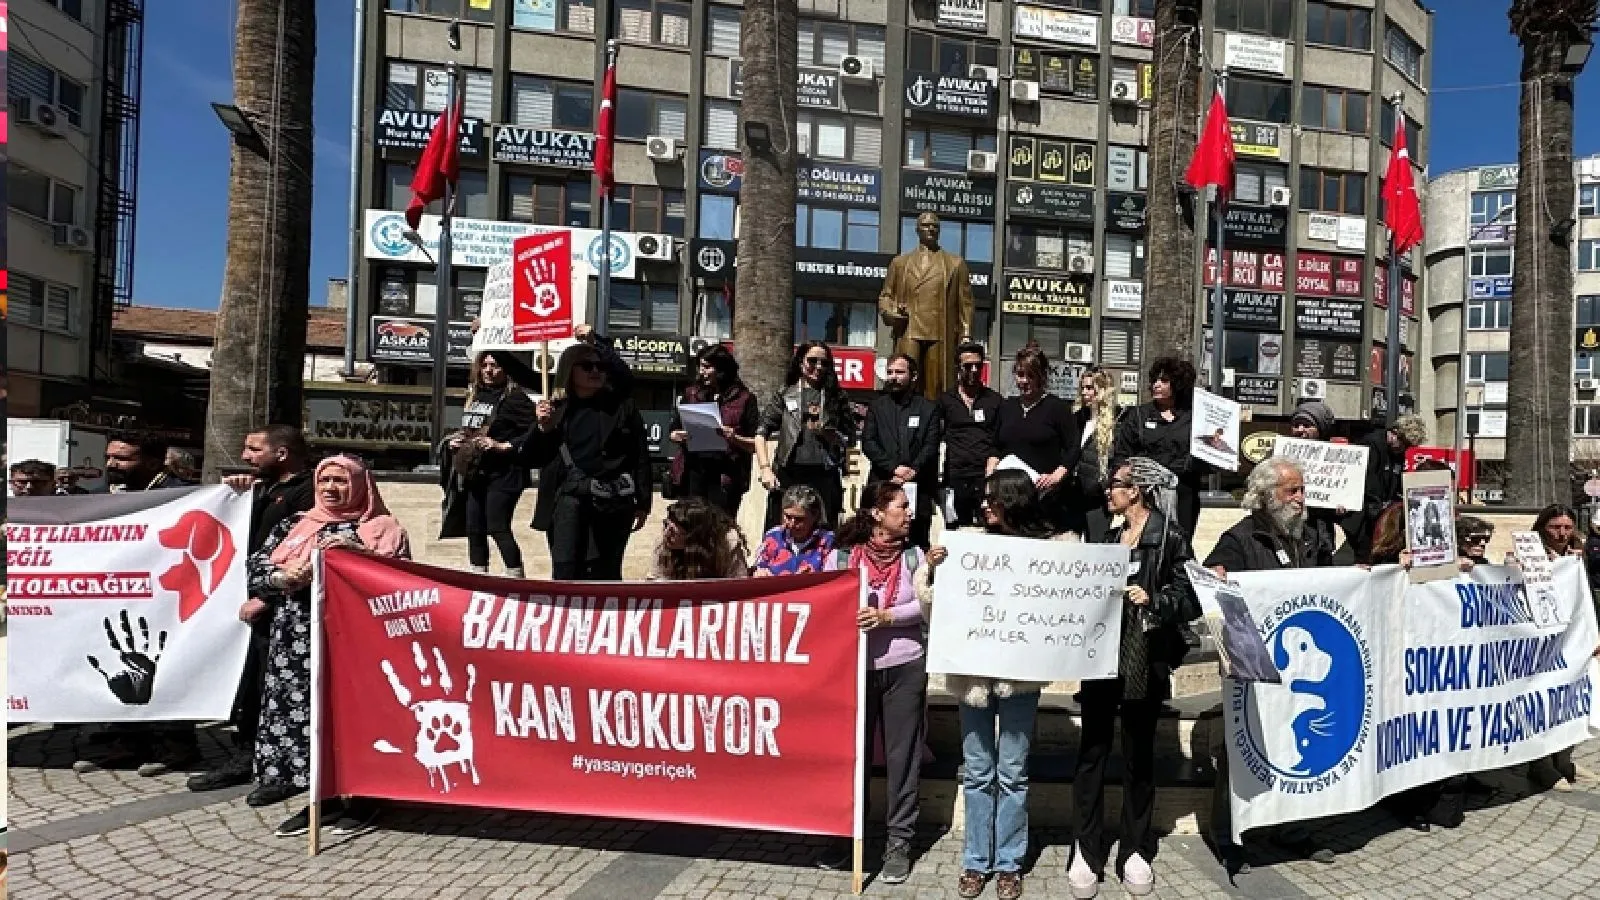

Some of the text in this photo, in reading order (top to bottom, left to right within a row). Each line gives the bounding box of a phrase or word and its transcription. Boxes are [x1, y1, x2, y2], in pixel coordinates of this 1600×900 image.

[938, 76, 987, 92] AVUKAT
[494, 126, 594, 151] AVUKAT
[811, 168, 875, 185] OĞULLARI
[926, 176, 973, 191] AVUKAT
[905, 185, 993, 206] NİHAN ARISU
[1227, 210, 1273, 224] AVUKAT
[1232, 249, 1257, 265] MAN
[1264, 253, 1282, 268] CA
[1010, 277, 1083, 294] AVUKAT
[1261, 270, 1283, 286] ME
[1233, 293, 1279, 307] AVUKAT
[379, 335, 429, 347] ASKAR
[833, 358, 863, 382] ER
[7, 546, 52, 567] EĞİL
[961, 552, 1014, 574] ONLAR
[27, 573, 152, 595] OLACAĞIZ!
[982, 604, 1007, 623] BU
[1274, 594, 1319, 620] SOKAK
[384, 618, 412, 638] DUR
[462, 590, 811, 664] BARINAKLARINIZ
[1404, 644, 1474, 695] SOKAK
[490, 681, 781, 758] KAN KOKUYOR
[1376, 708, 1441, 774] KORUMA
[1446, 706, 1475, 752] VE
